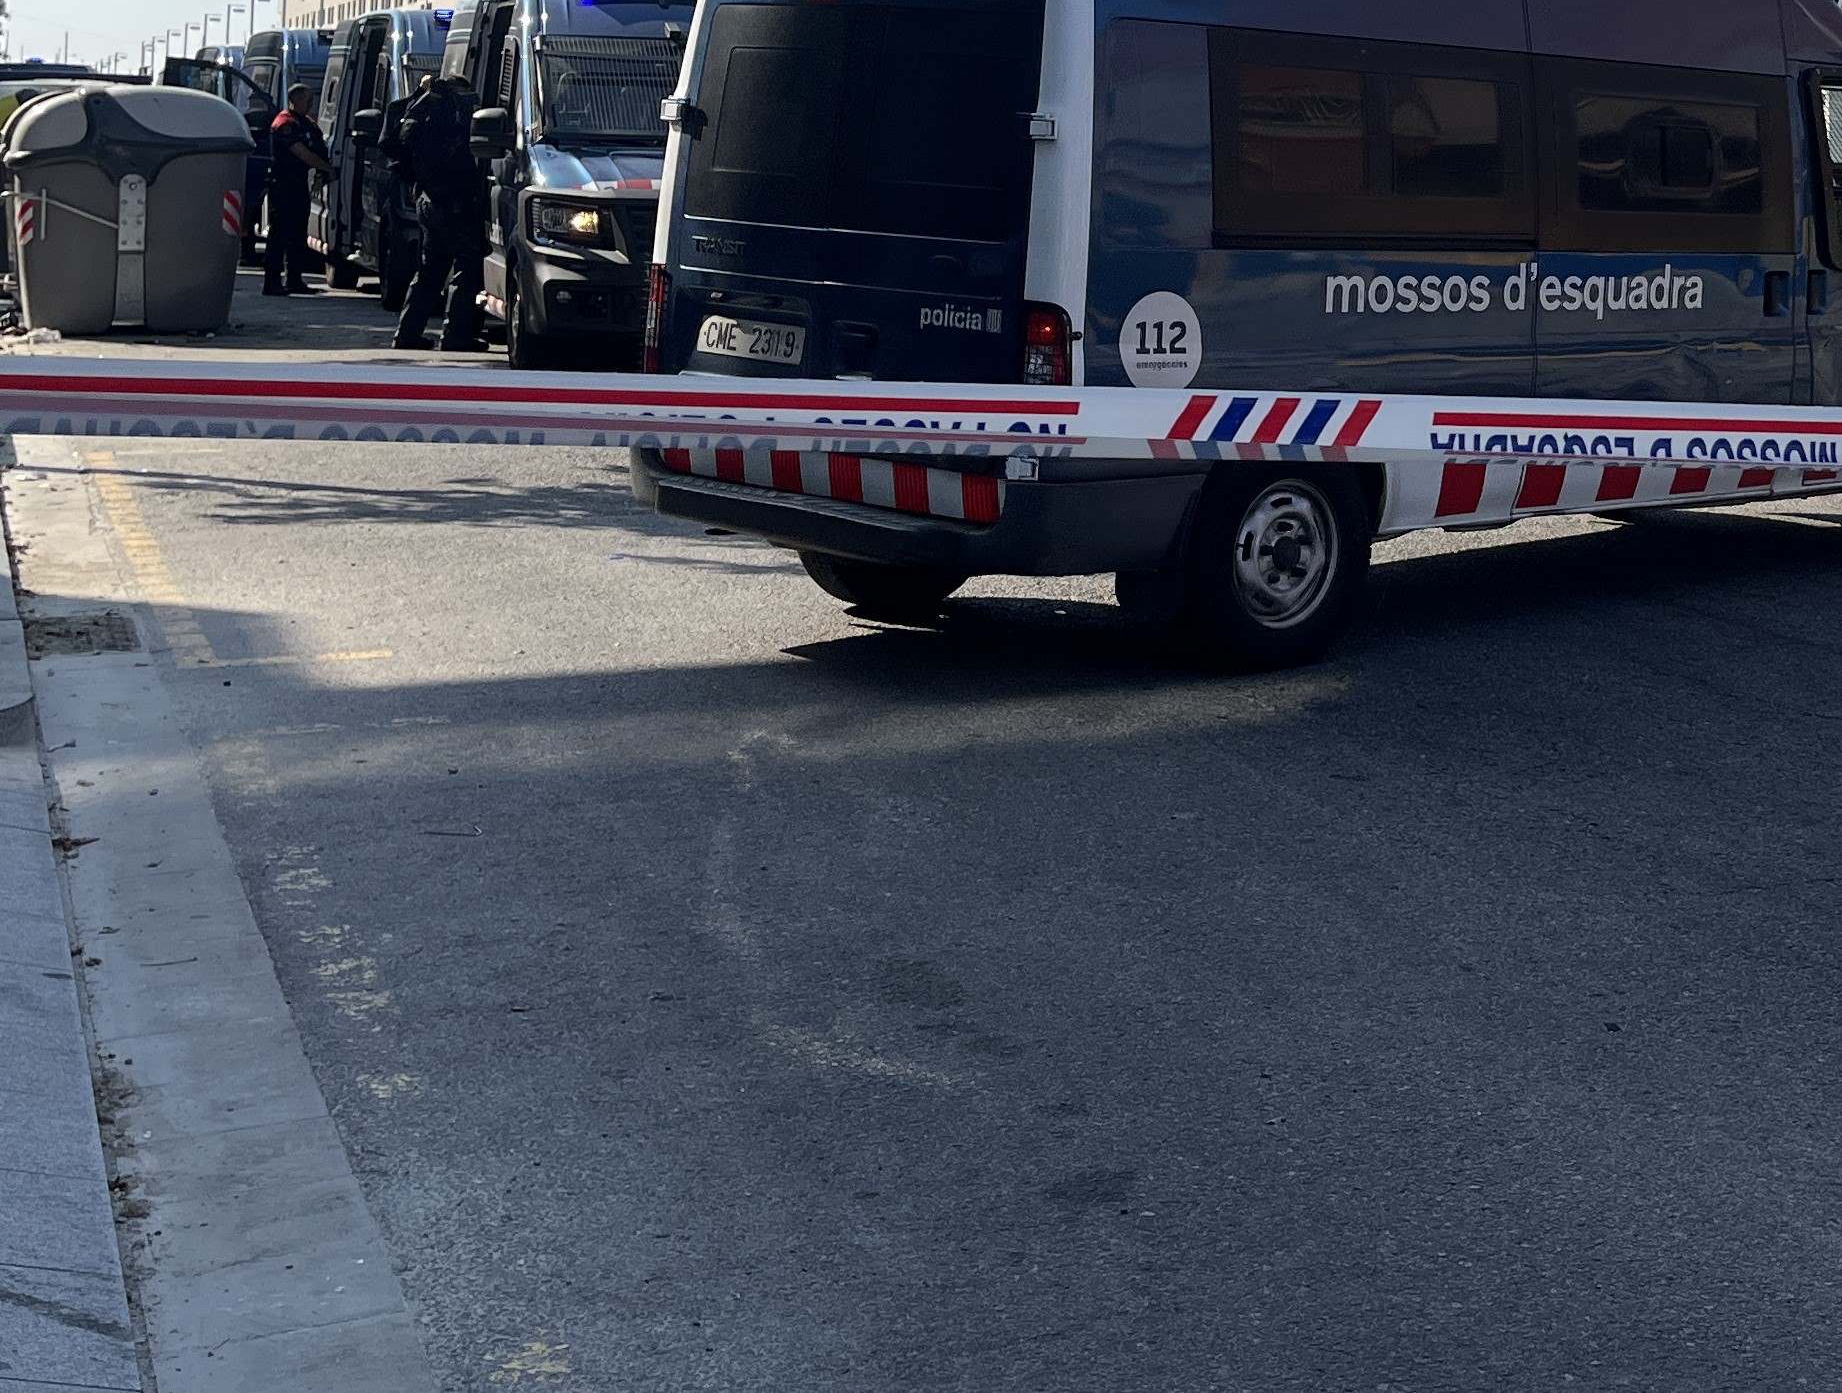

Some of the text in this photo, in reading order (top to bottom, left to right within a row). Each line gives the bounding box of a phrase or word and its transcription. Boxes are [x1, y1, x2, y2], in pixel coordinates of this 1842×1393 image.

[1325, 262, 1703, 319] mossos d'esquadra
[919, 303, 982, 330] policia
[705, 321, 737, 351] CME
[1135, 320, 1187, 355] 112
